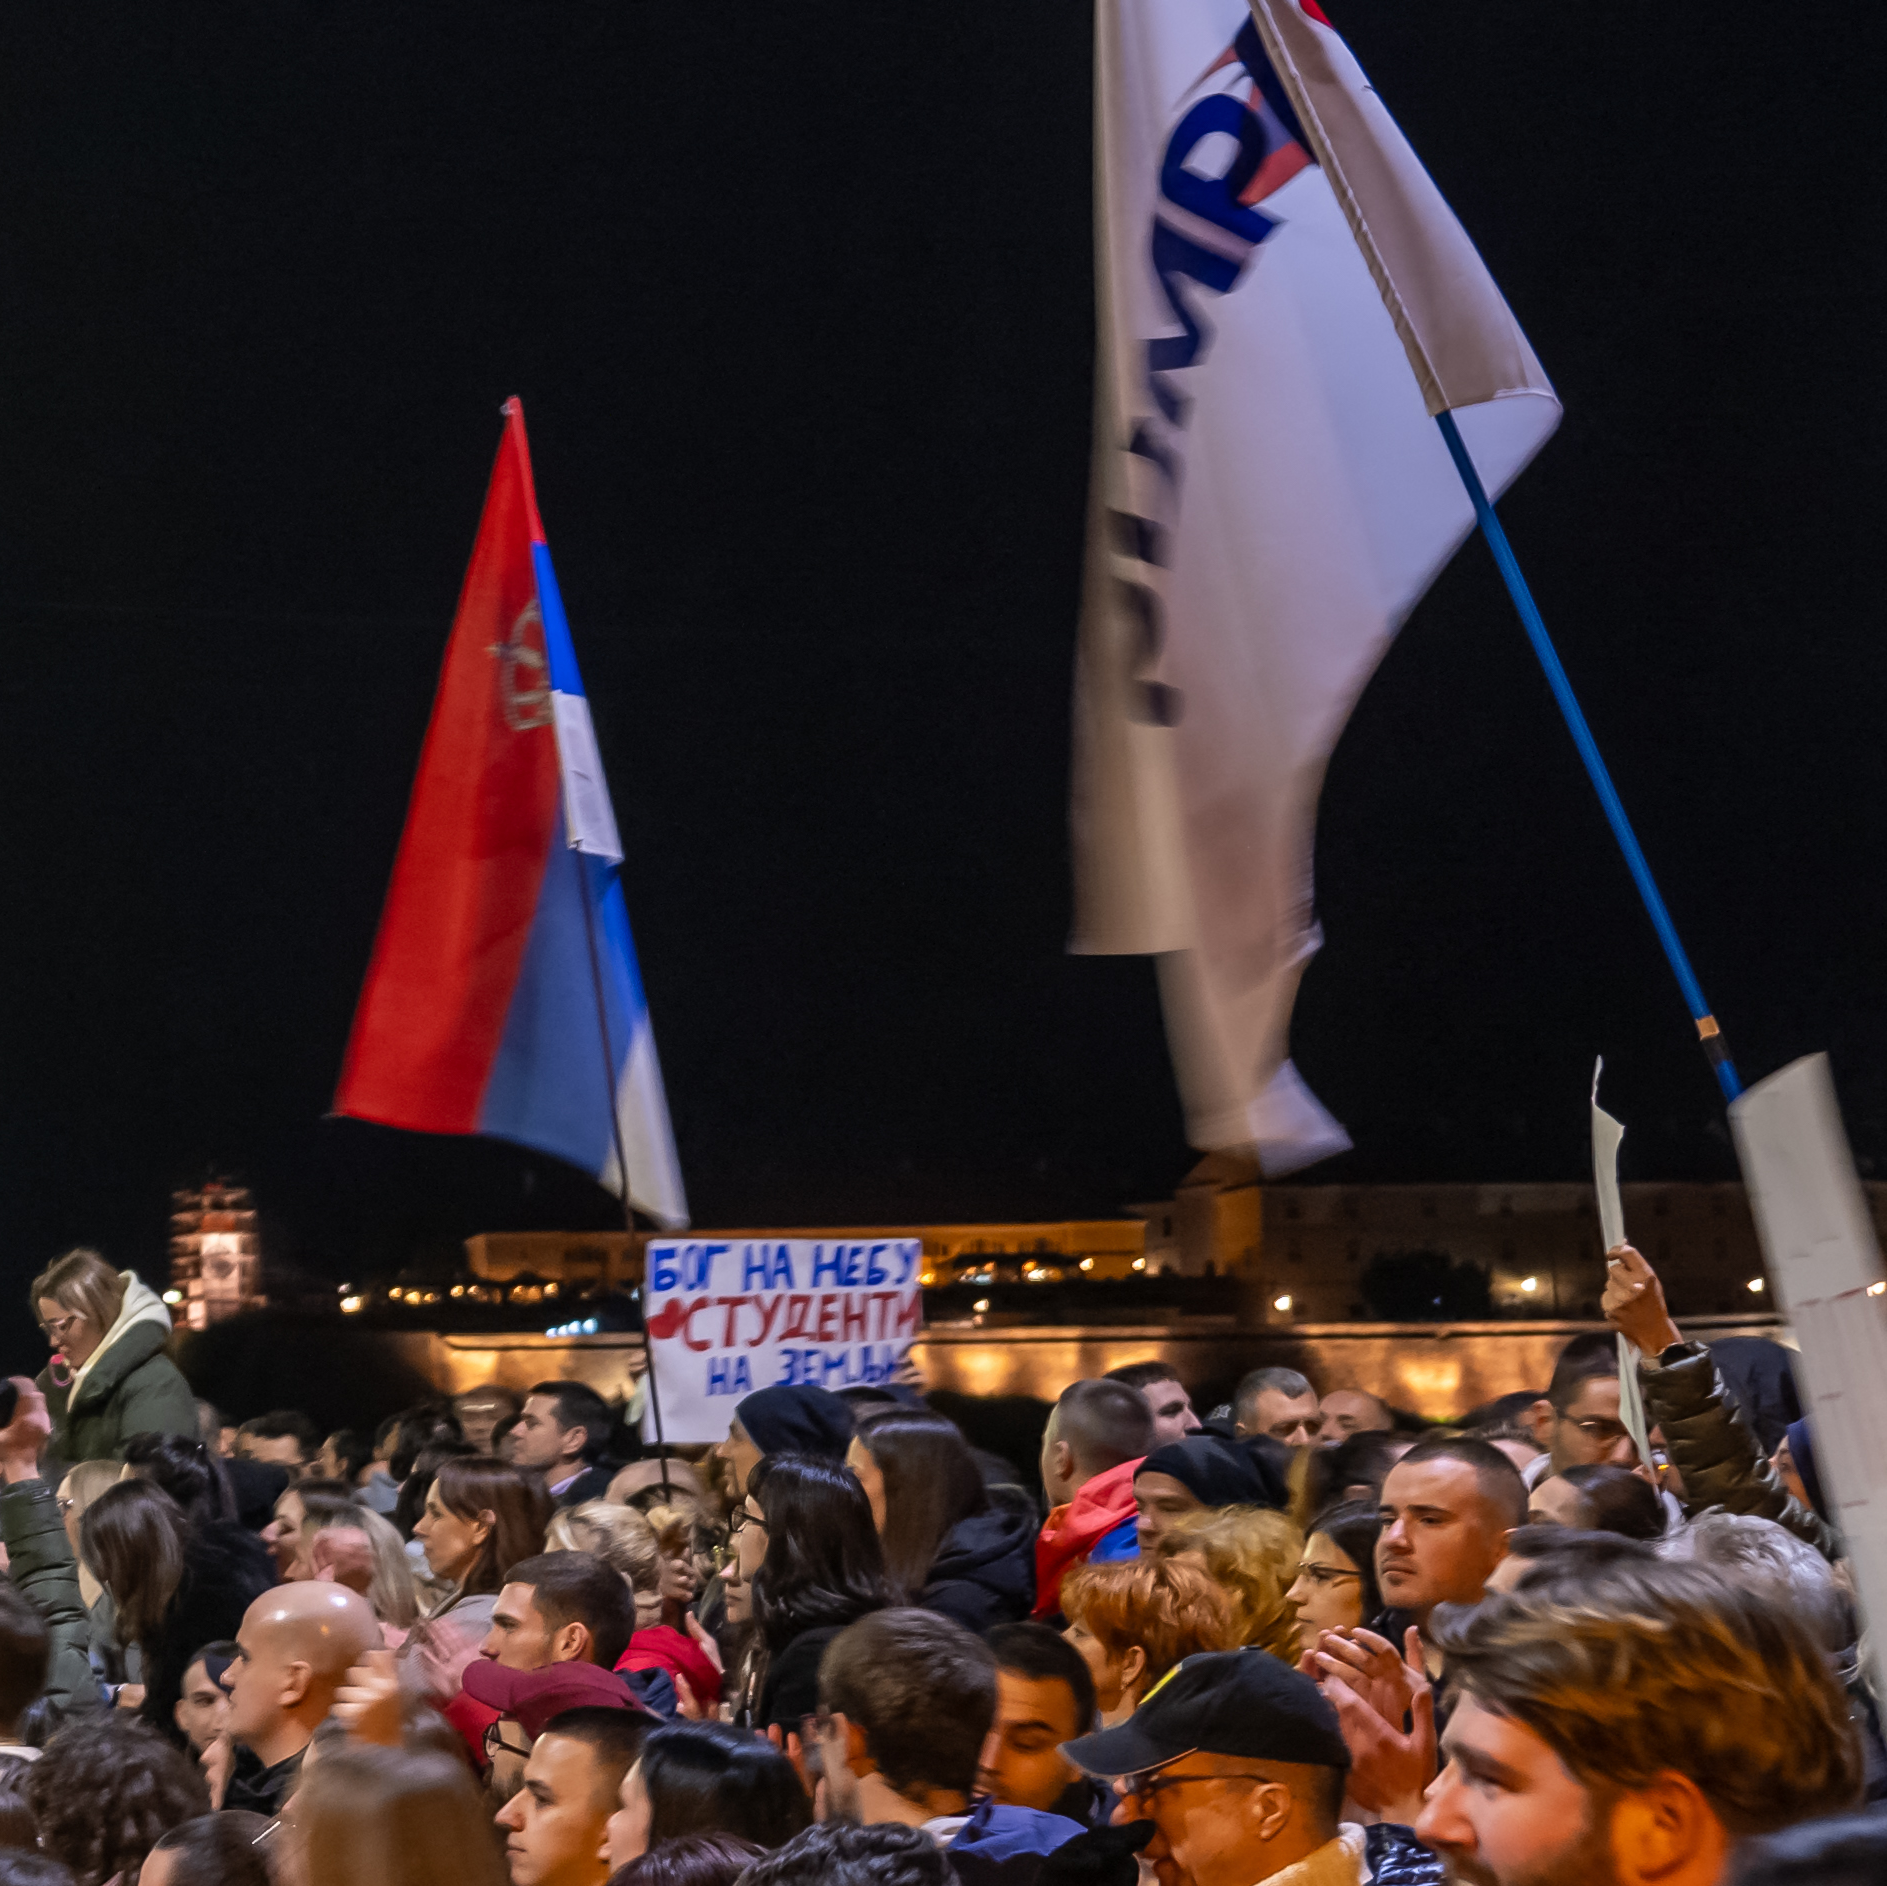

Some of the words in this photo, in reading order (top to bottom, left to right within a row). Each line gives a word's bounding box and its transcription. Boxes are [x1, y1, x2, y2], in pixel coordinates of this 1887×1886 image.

[651, 1243, 730, 1291] БОГ
[742, 1243, 794, 1291] НА
[812, 1242, 921, 1288] НЕБУ
[683, 1289, 922, 1351] СТУДЕНТИ
[706, 1354, 752, 1396] НА
